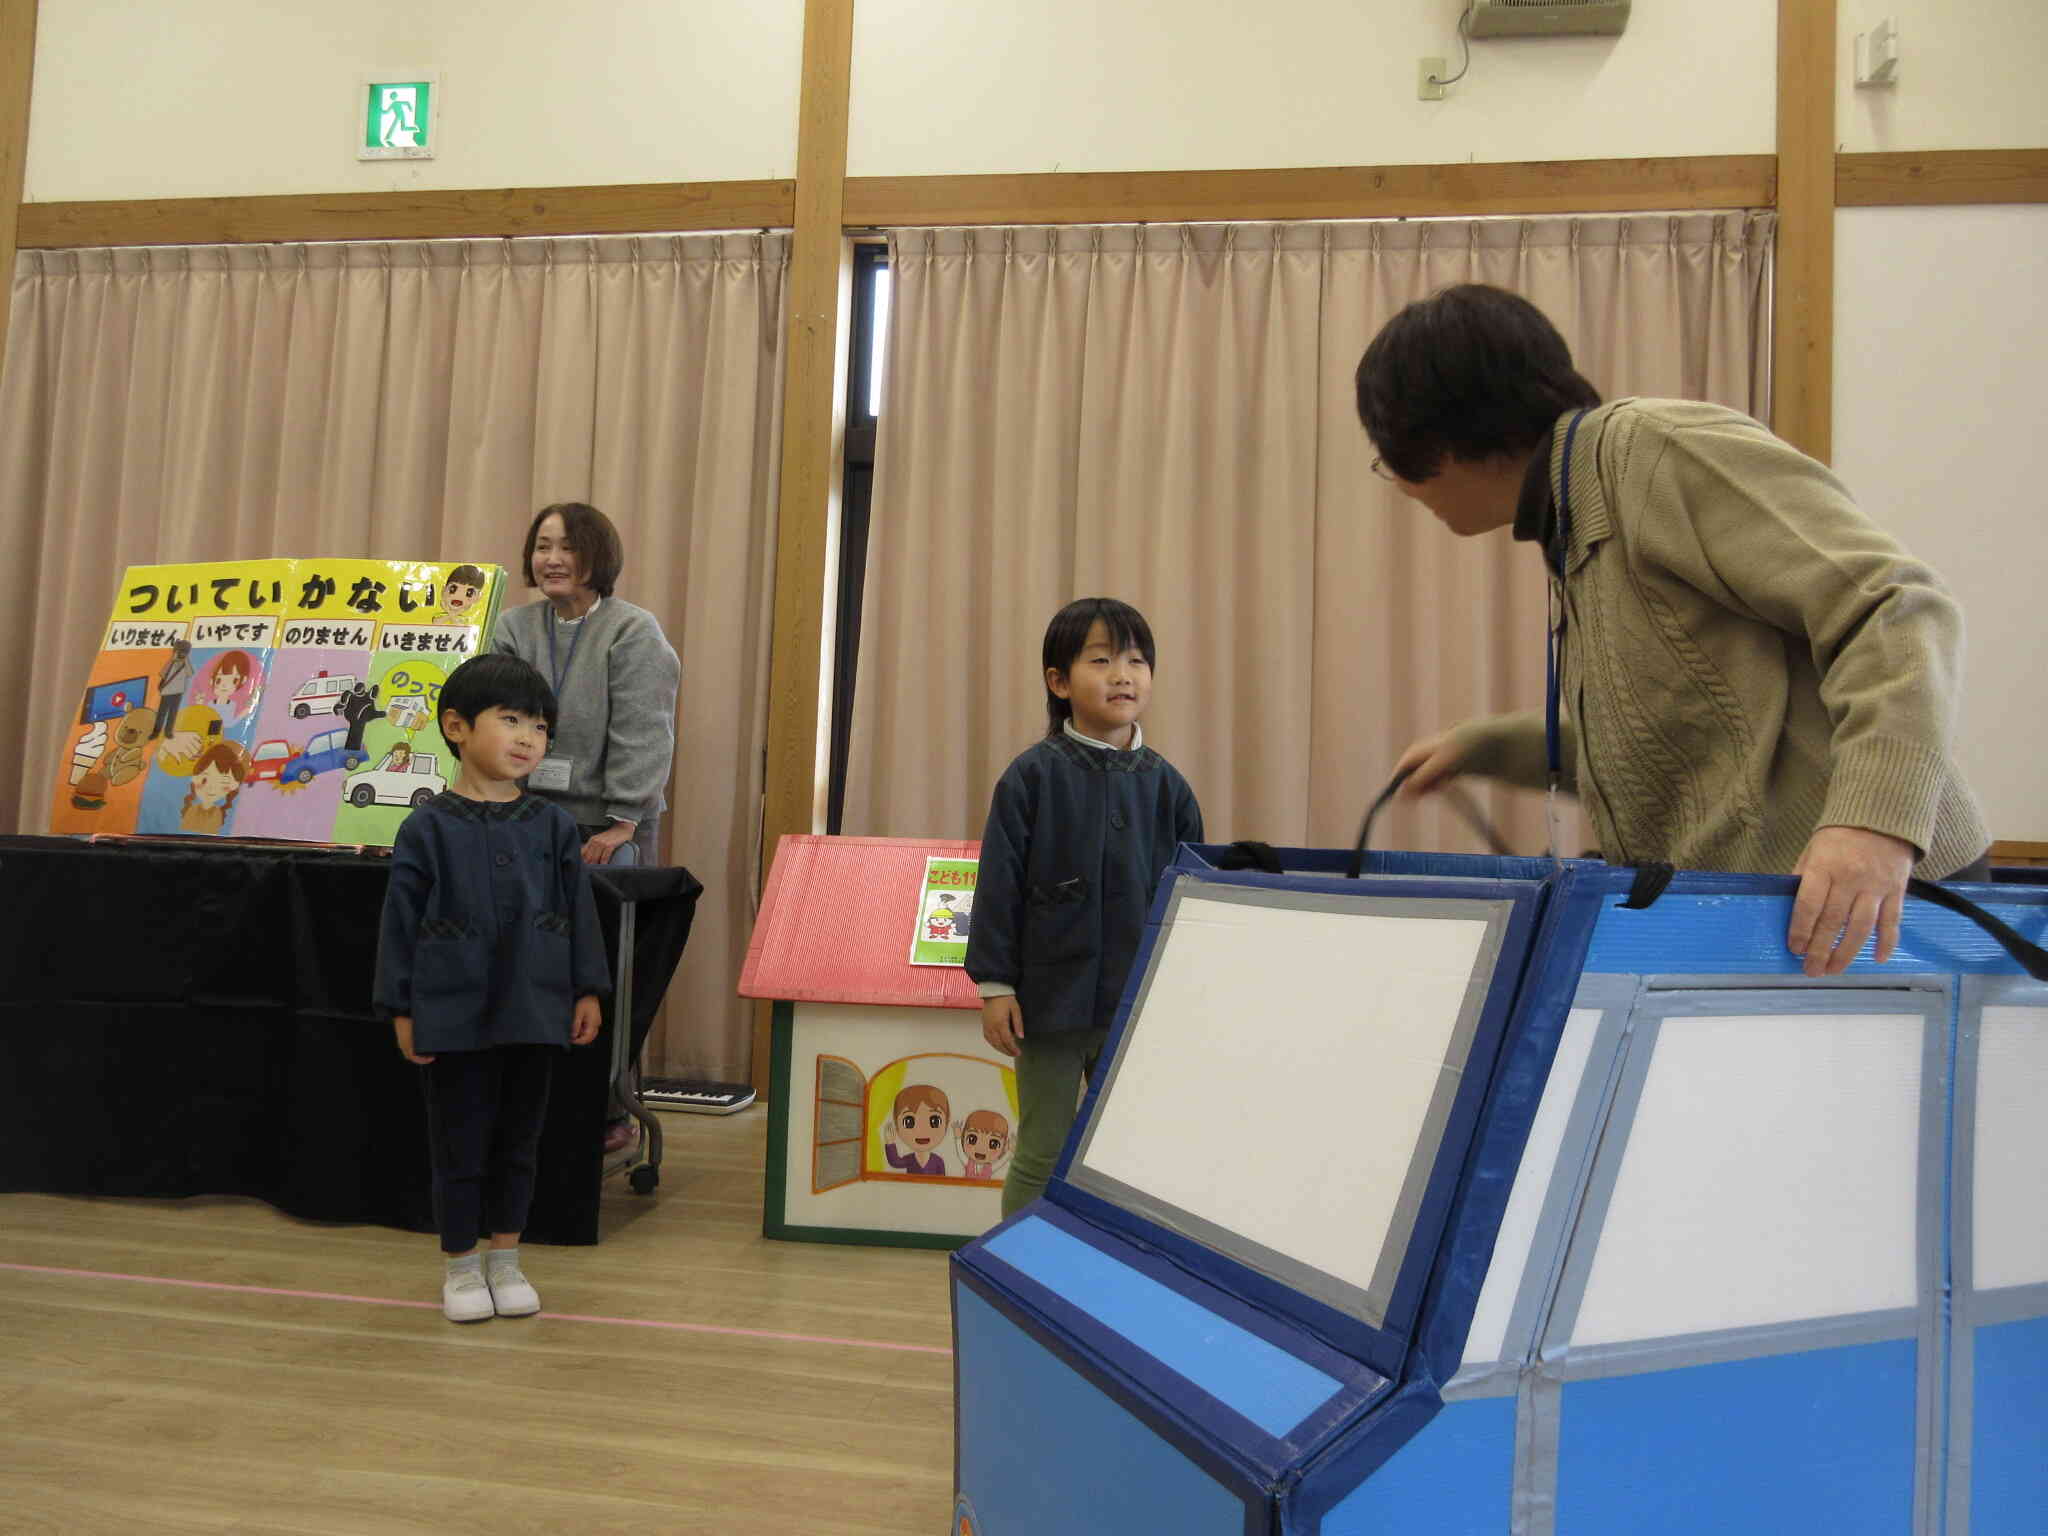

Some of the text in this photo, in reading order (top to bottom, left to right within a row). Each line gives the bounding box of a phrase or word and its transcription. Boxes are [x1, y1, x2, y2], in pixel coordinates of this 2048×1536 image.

[130, 574, 435, 614] ついていかない
[111, 628, 180, 647] いりません
[197, 622, 268, 642] いやです
[285, 627, 368, 646] のりません
[382, 631, 468, 652] いきません
